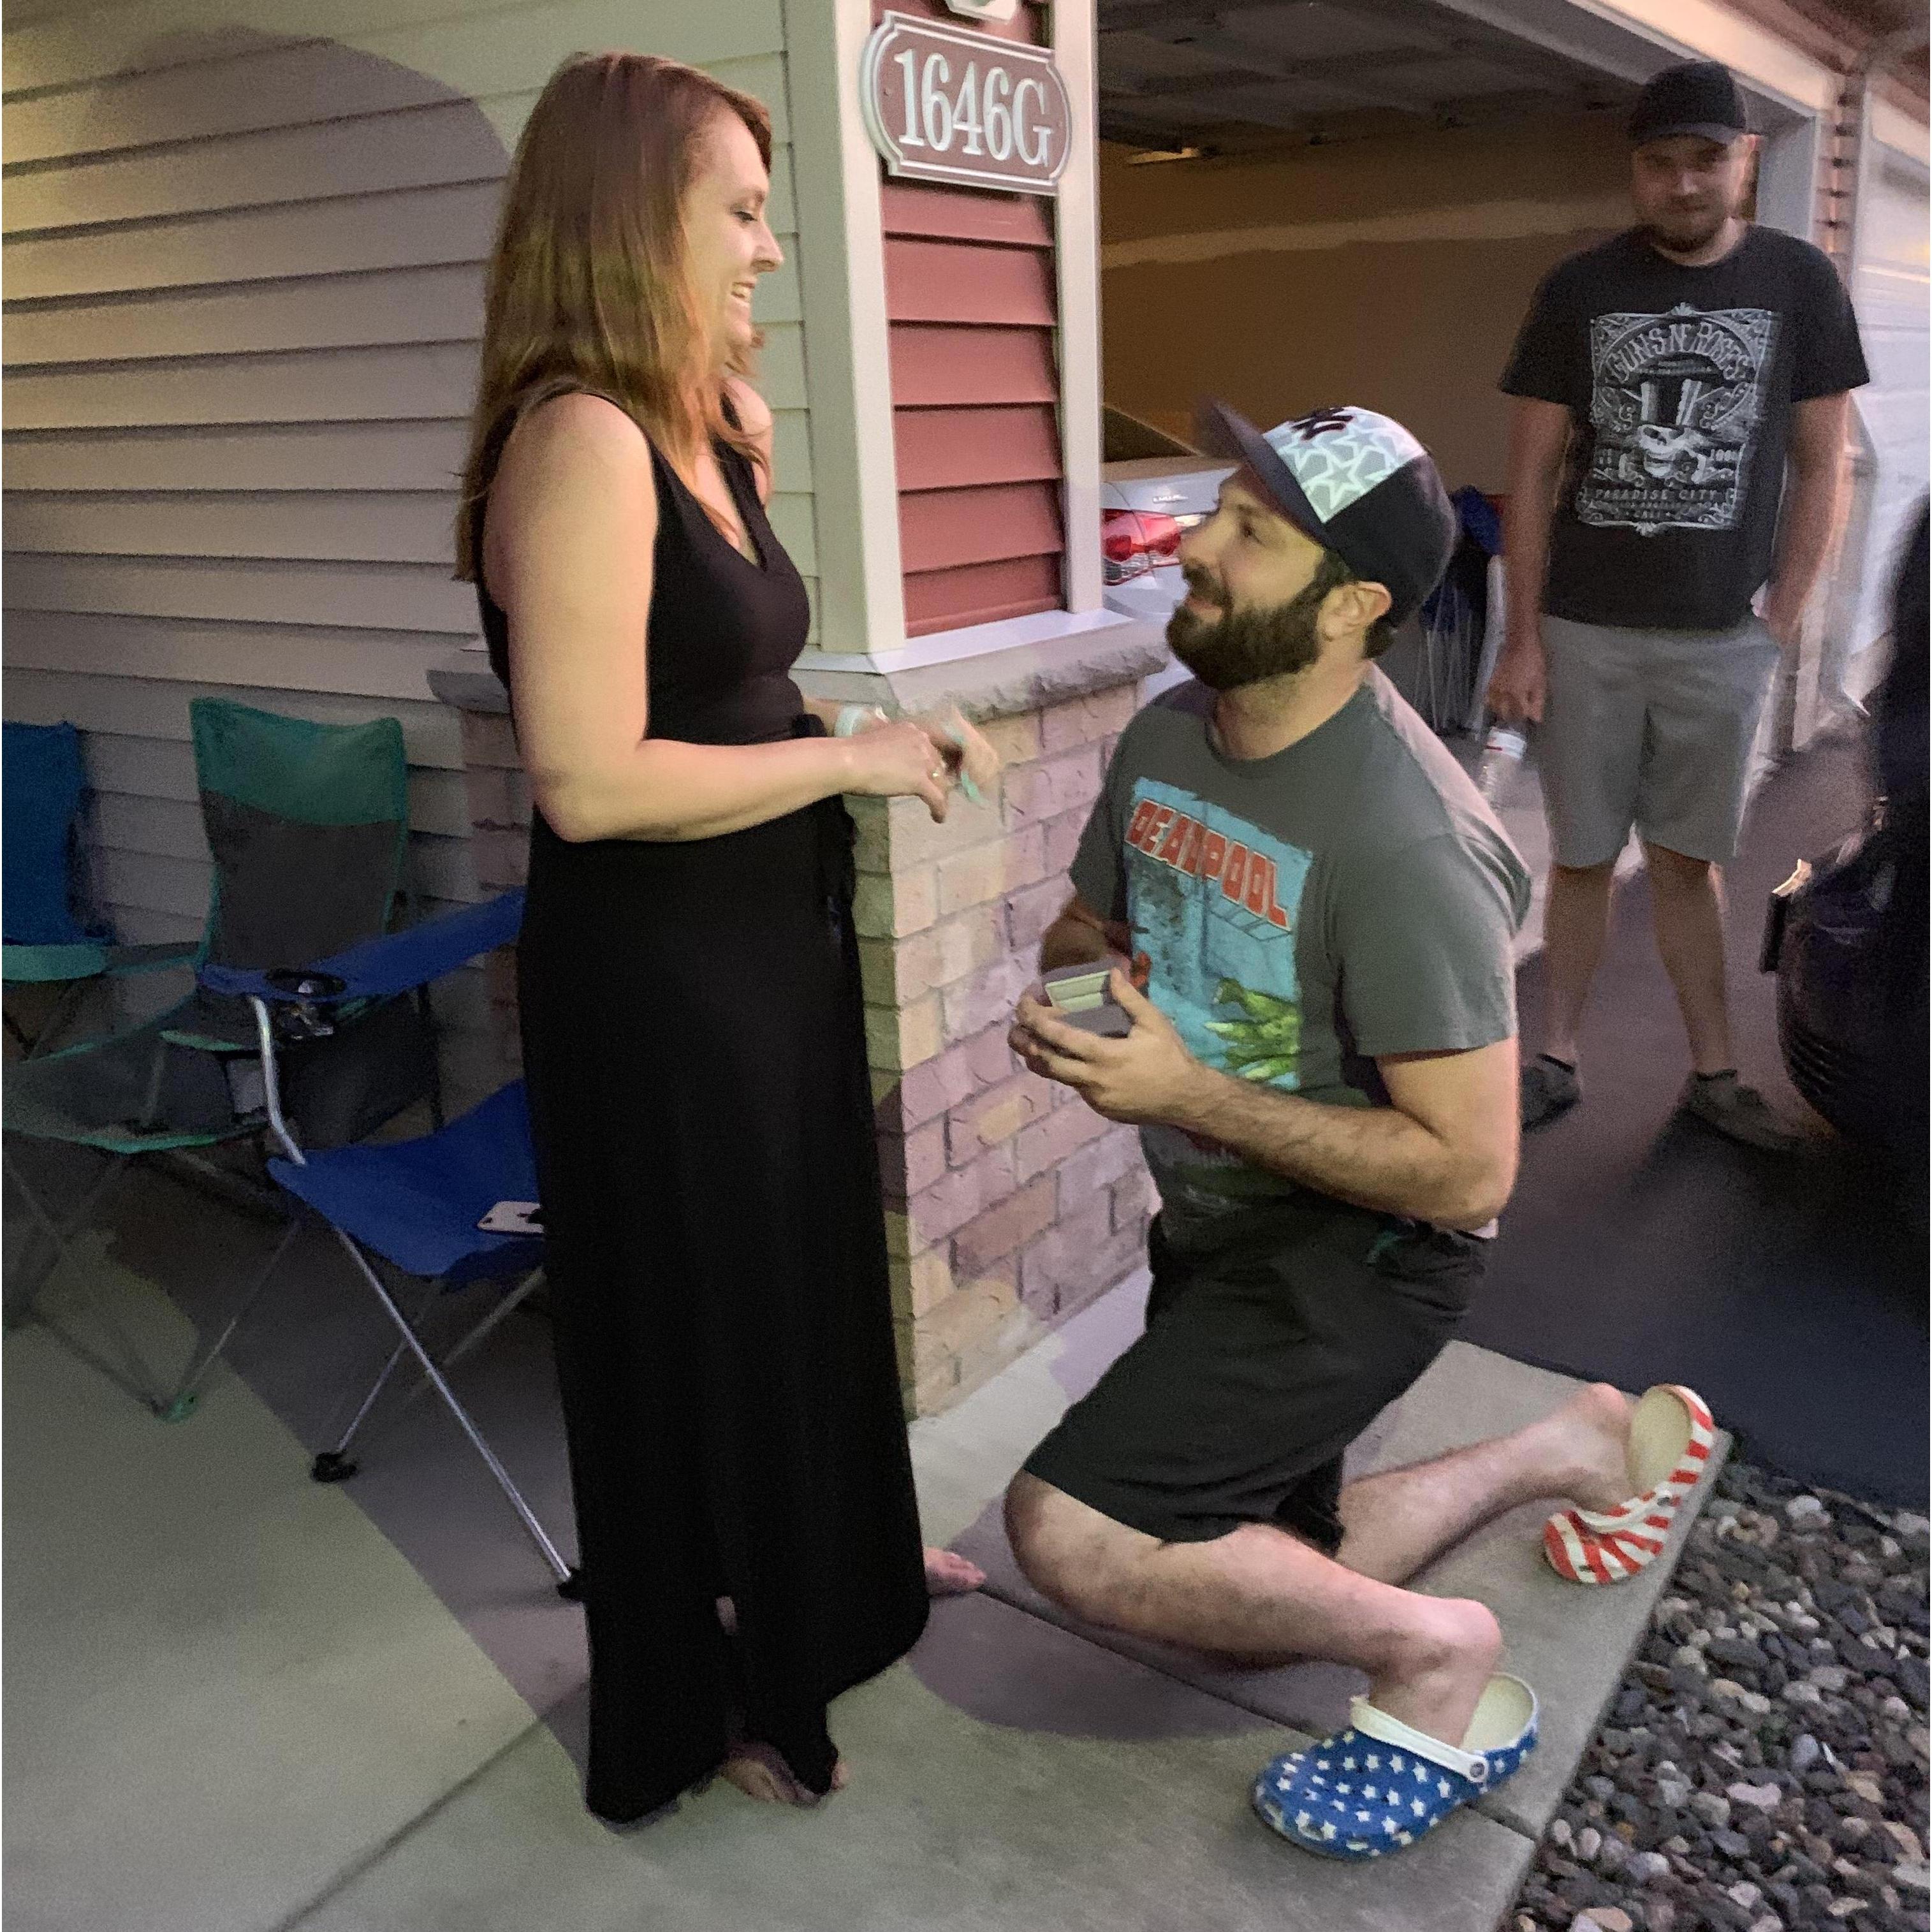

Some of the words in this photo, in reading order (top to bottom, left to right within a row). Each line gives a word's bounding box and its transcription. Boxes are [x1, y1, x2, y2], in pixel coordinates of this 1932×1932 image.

[894, 48, 1053, 167] 1646G
[1605, 328, 1665, 383] GUNS
[1693, 321, 1752, 380] ROSES
[1679, 489, 1717, 501] CITY
